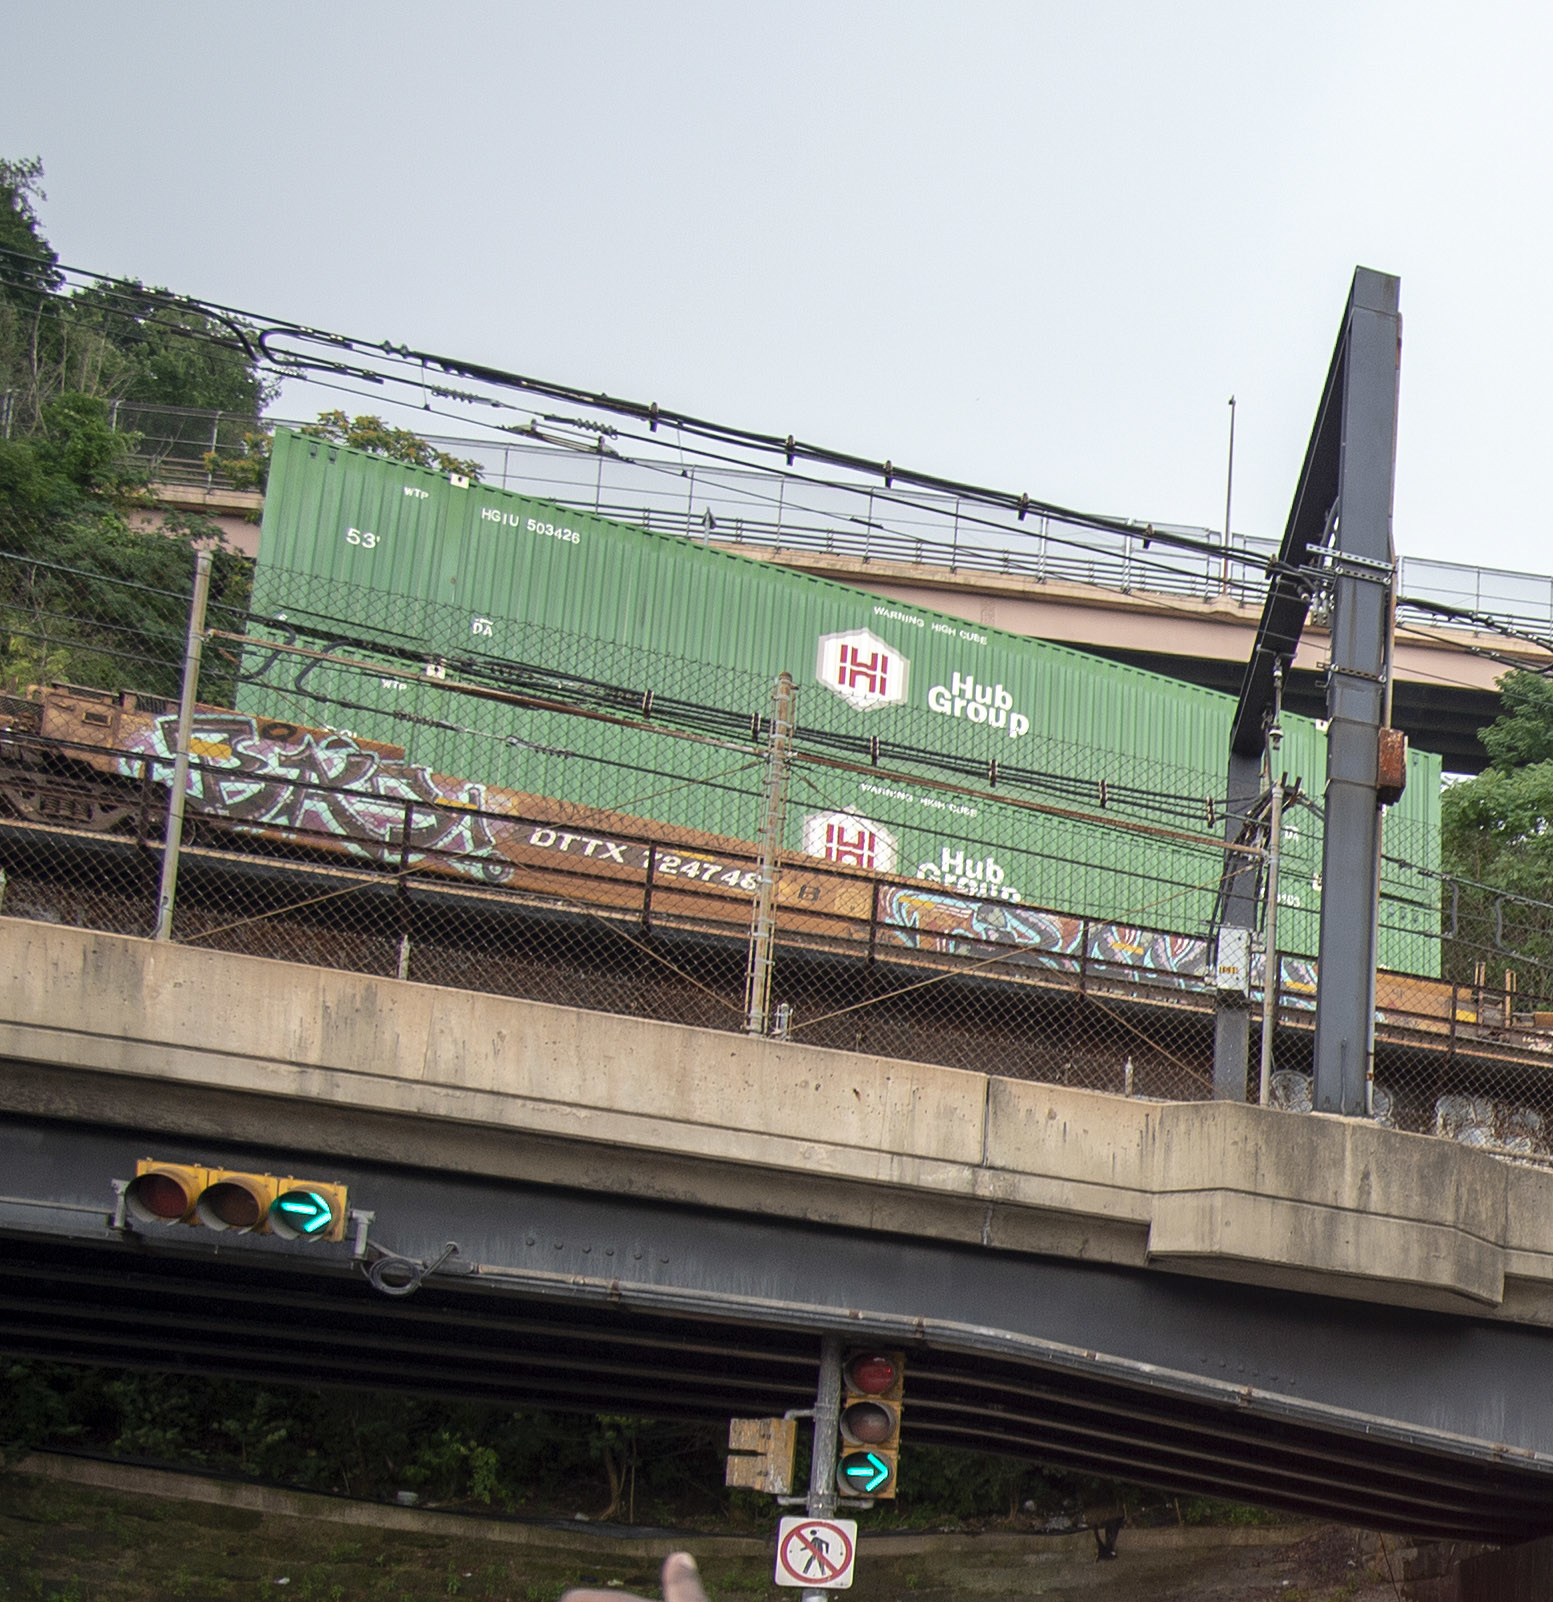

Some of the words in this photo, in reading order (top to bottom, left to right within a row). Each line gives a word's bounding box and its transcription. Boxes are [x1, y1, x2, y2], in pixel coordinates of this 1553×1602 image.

[403, 486, 429, 500] WTP
[346, 527, 380, 548] 53'
[481, 507, 519, 527] HGIU
[527, 519, 580, 544] 503426
[873, 605, 925, 628] WARNING
[931, 622, 957, 638] HIGH
[959, 630, 988, 646] CUBE
[951, 671, 1013, 711] Hub
[927, 684, 1030, 739] Group
[529, 827, 628, 863] DTTX
[940, 847, 1005, 884] Hub
